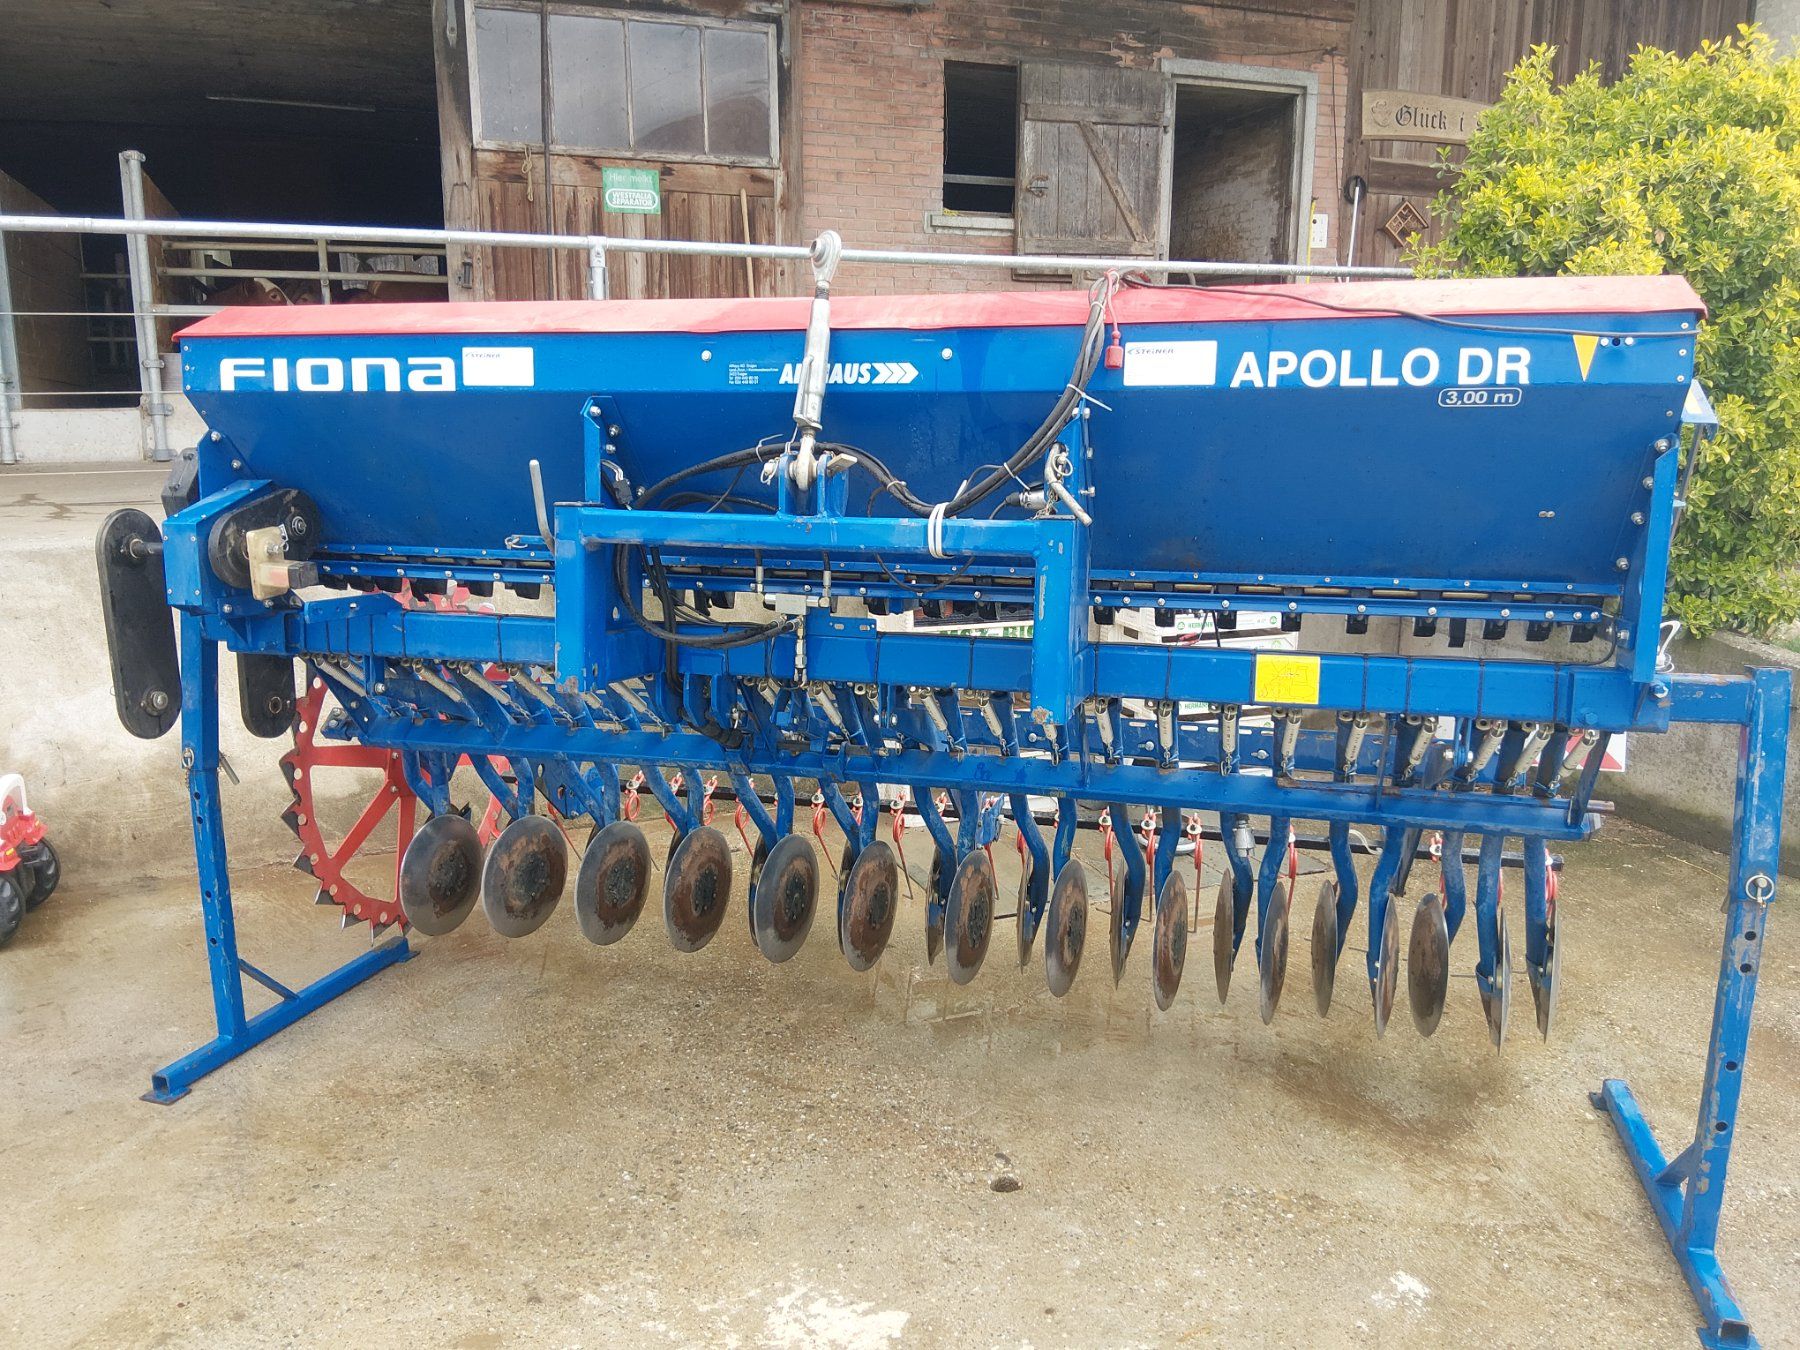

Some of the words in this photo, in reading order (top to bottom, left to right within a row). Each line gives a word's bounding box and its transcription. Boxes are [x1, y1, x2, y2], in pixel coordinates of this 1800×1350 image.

[1395, 104, 1447, 131] Glück
[609, 172, 626, 182] Hier
[611, 191, 652, 200] WESTFALIA
[611, 198, 653, 207] SEPARATOR
[1229, 348, 1440, 388] APOLLO
[1457, 346, 1531, 386] DR
[1445, 390, 1488, 406] 3,00
[1493, 393, 1514, 404] m
